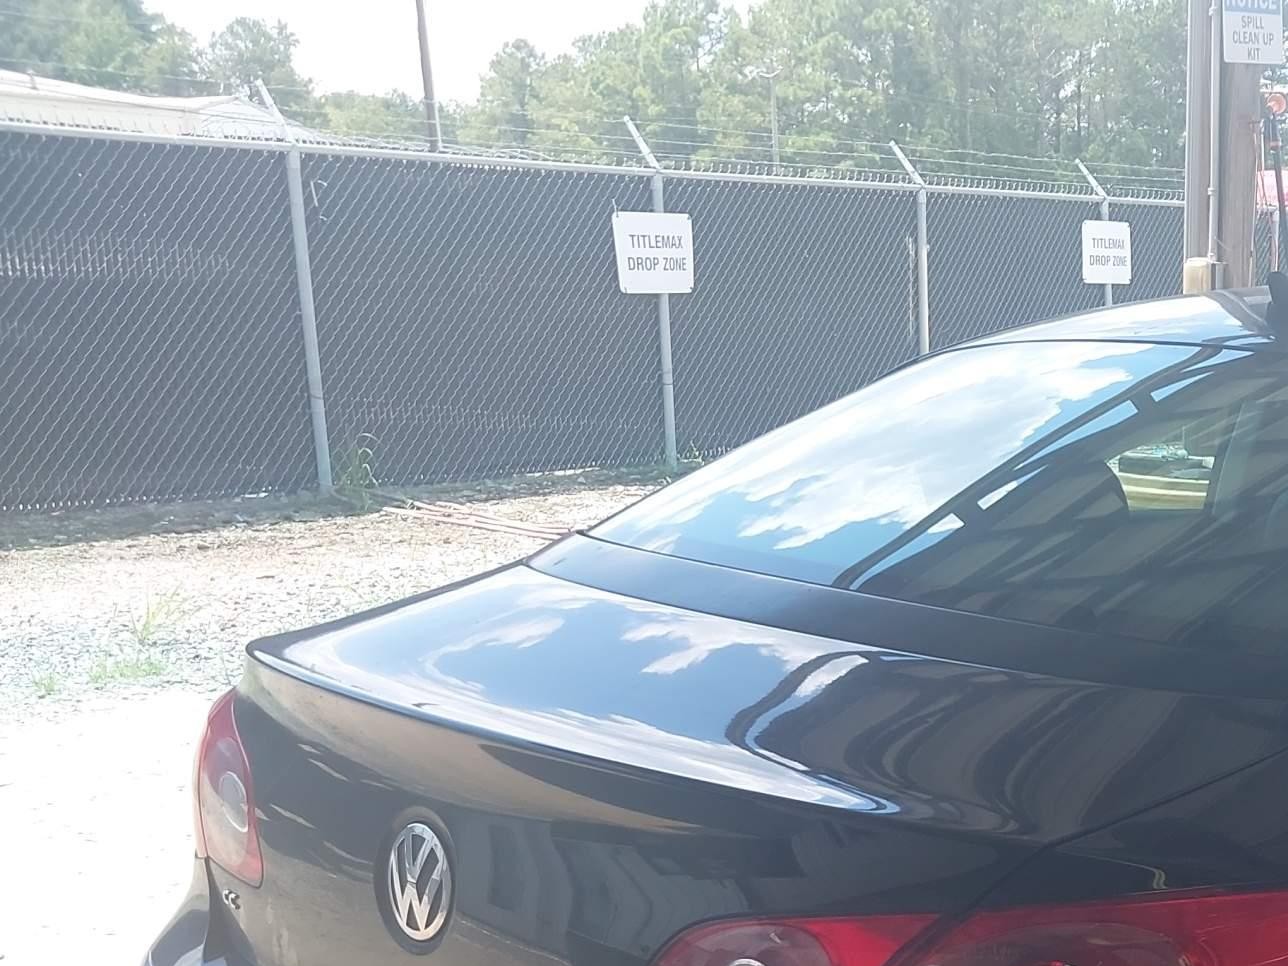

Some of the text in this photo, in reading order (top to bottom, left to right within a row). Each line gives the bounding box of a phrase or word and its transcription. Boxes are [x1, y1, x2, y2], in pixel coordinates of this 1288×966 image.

[1241, 15, 1264, 29] SPILL
[1232, 30, 1274, 46] CLEAN UP
[1247, 47, 1261, 60] KIT
[628, 234, 683, 249] TITLEMAX
[627, 256, 687, 271] DROP ZONE
[1089, 254, 1128, 267] DROP ZONE
